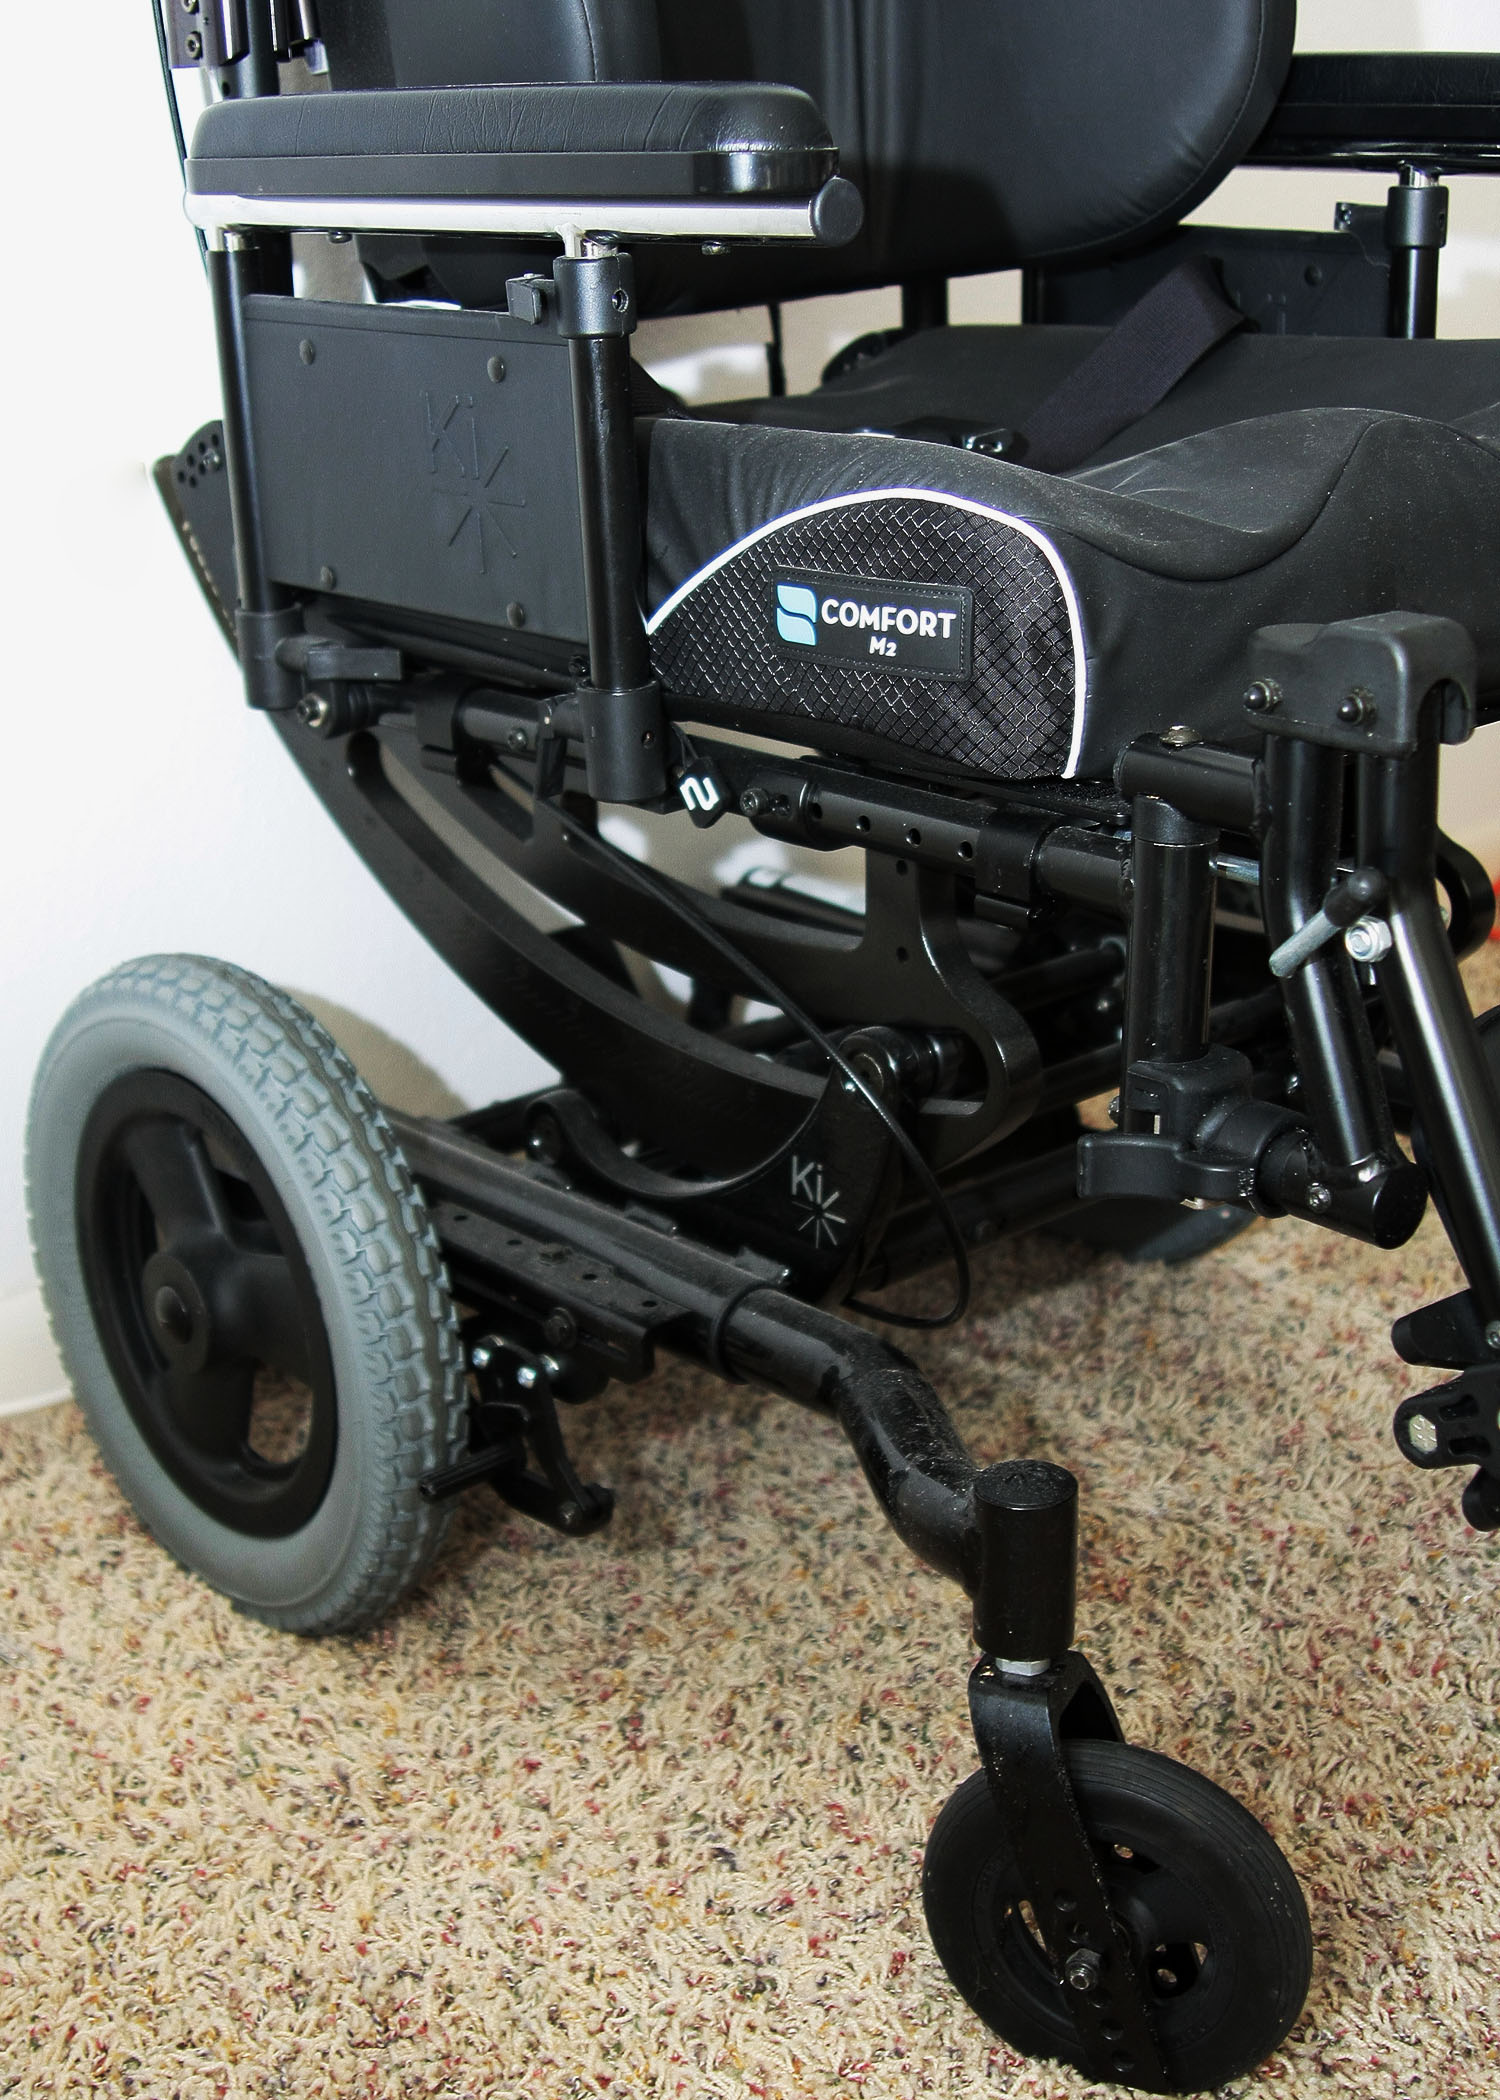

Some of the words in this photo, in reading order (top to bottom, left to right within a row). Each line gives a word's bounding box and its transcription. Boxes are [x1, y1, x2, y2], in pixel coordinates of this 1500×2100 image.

[821, 597, 957, 639] COMFORT
[869, 635, 898, 657] M2
[792, 1155, 823, 1204] Ki
